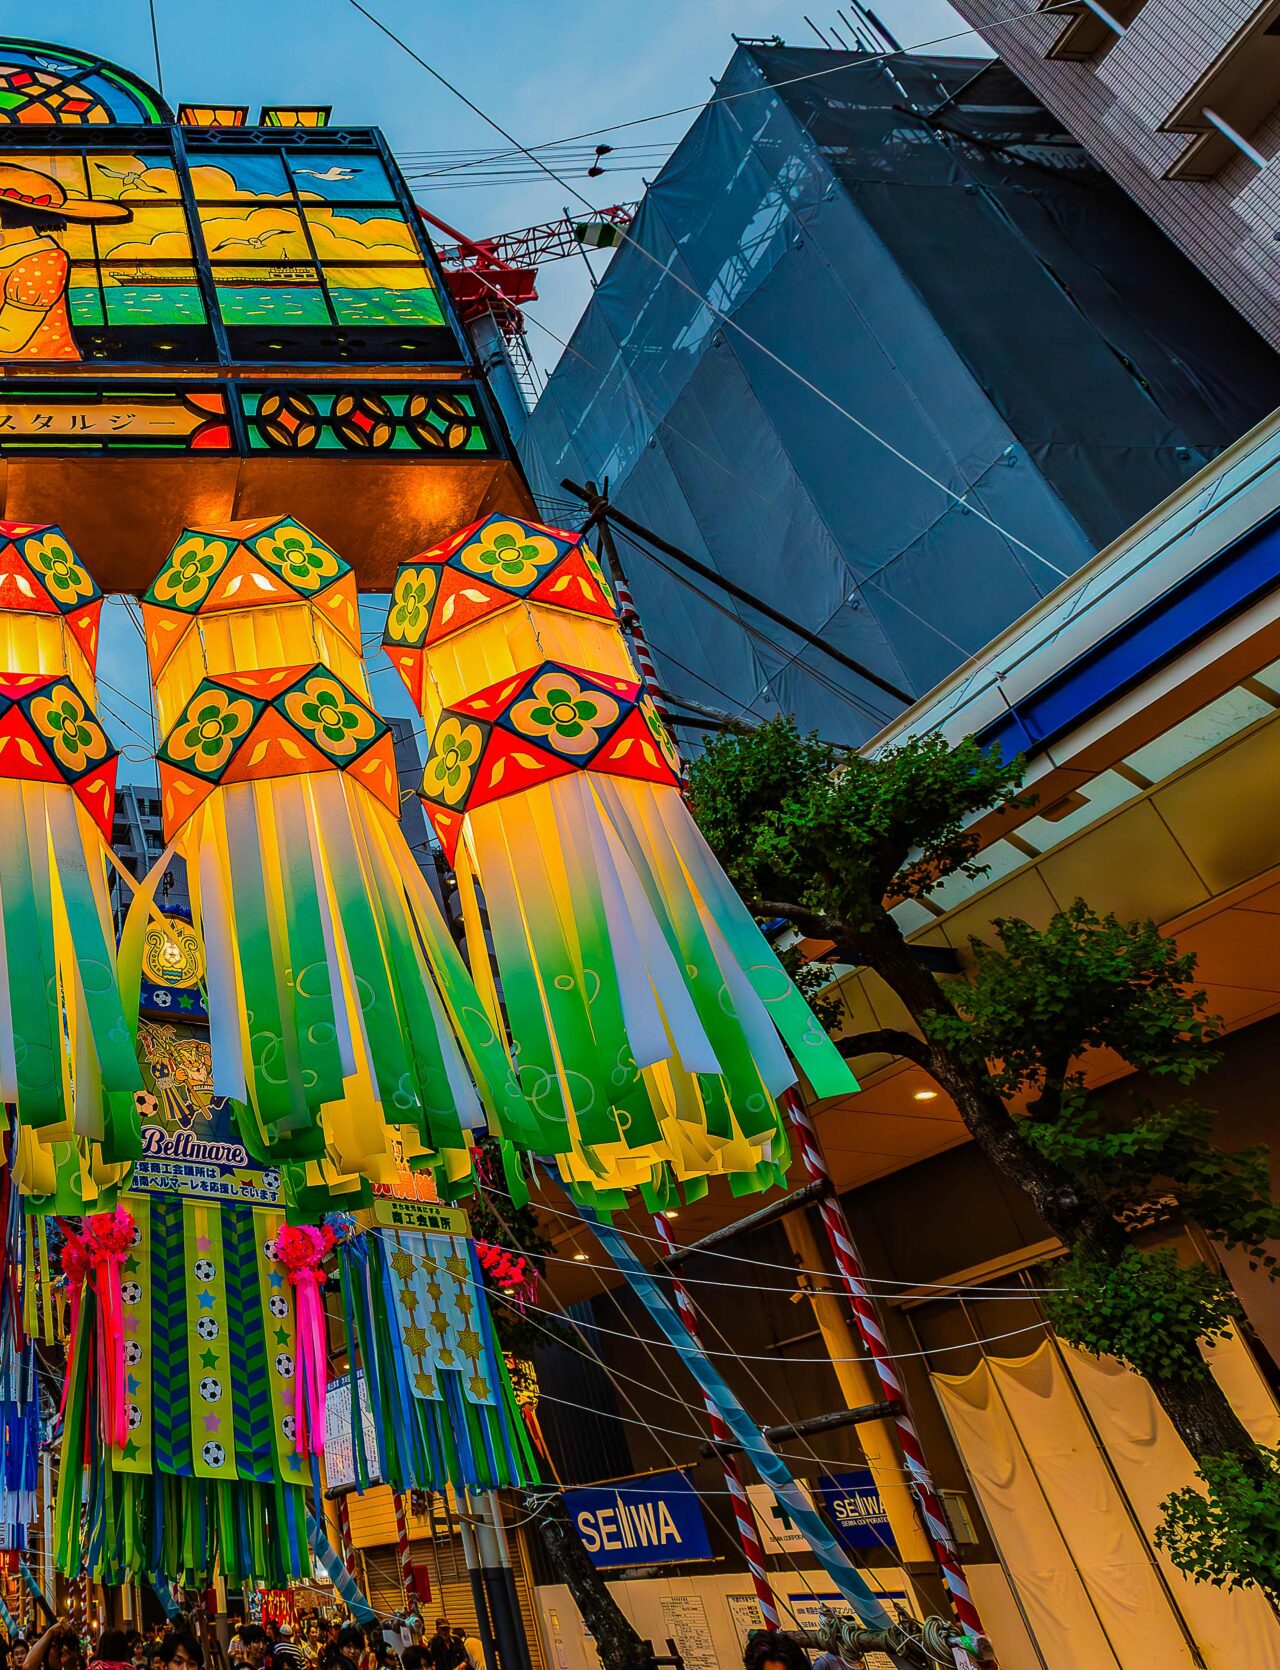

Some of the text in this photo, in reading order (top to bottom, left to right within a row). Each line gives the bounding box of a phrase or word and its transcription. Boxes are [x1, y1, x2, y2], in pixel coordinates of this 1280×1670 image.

[141, 1126, 247, 1166] Bellmare
[391, 1210, 452, 1230] 商工会議所
